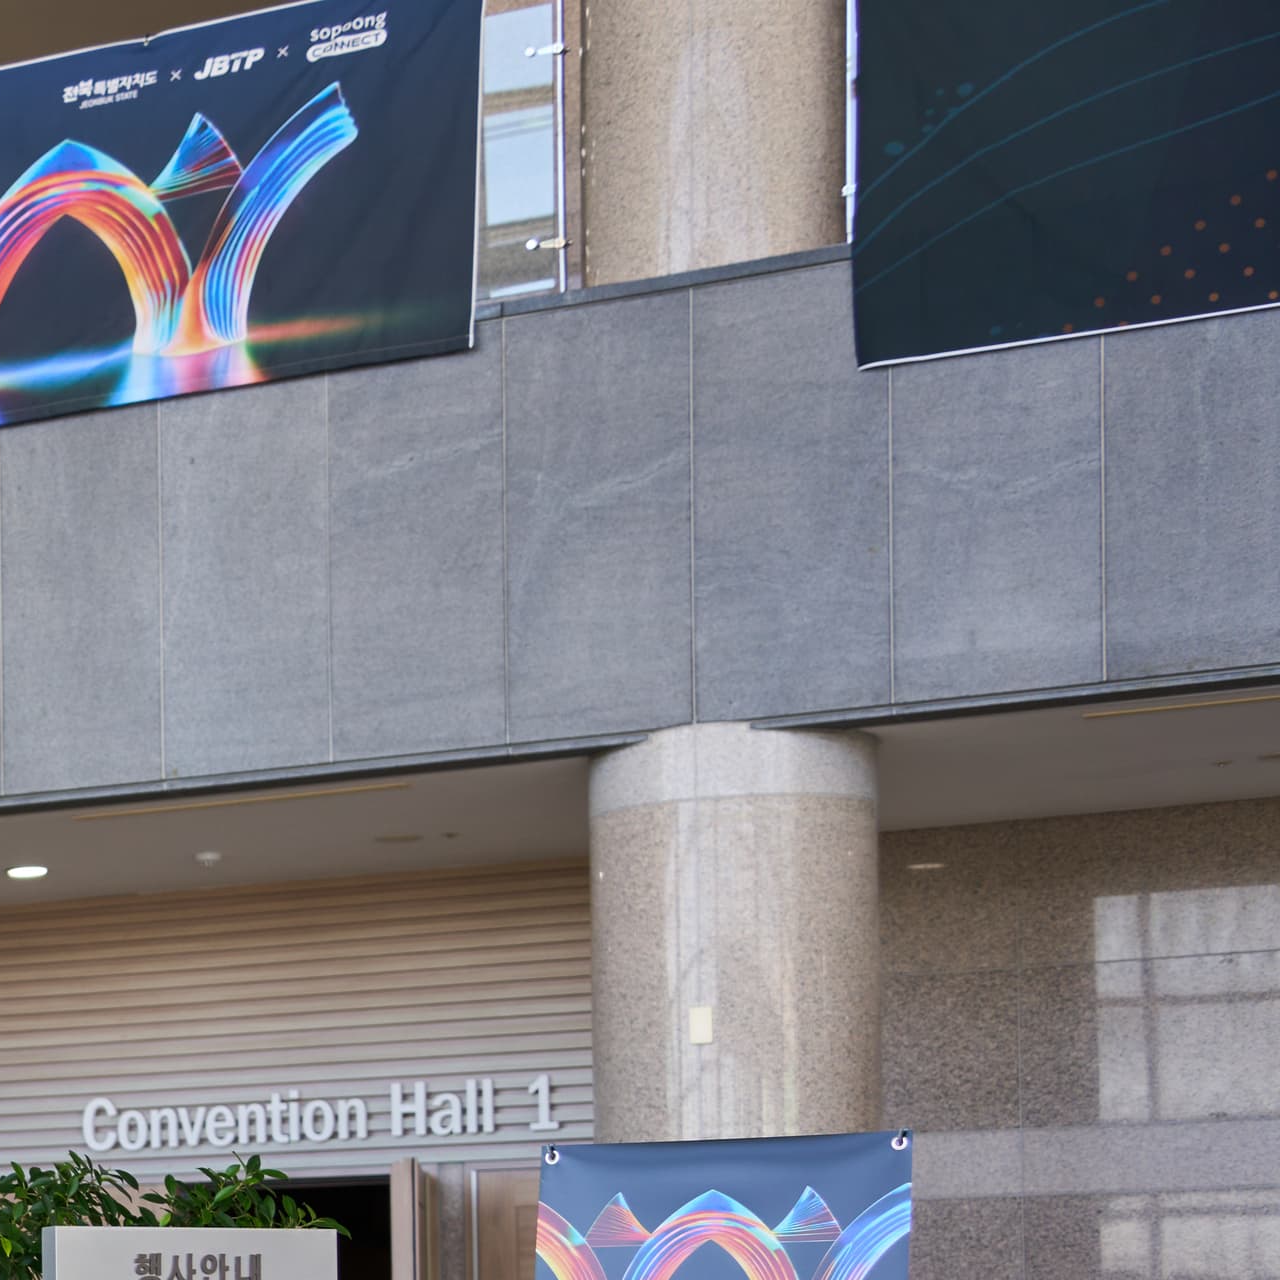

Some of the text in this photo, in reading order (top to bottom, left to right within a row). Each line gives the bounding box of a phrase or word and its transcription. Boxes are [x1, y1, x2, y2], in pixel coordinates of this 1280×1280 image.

[309, 11, 387, 43] sopoong
[310, 31, 383, 60] CONNECT
[193, 47, 266, 81] JBTP
[62, 70, 158, 103] 전북특별자치도
[81, 1074, 561, 1152] Convention Hall 1
